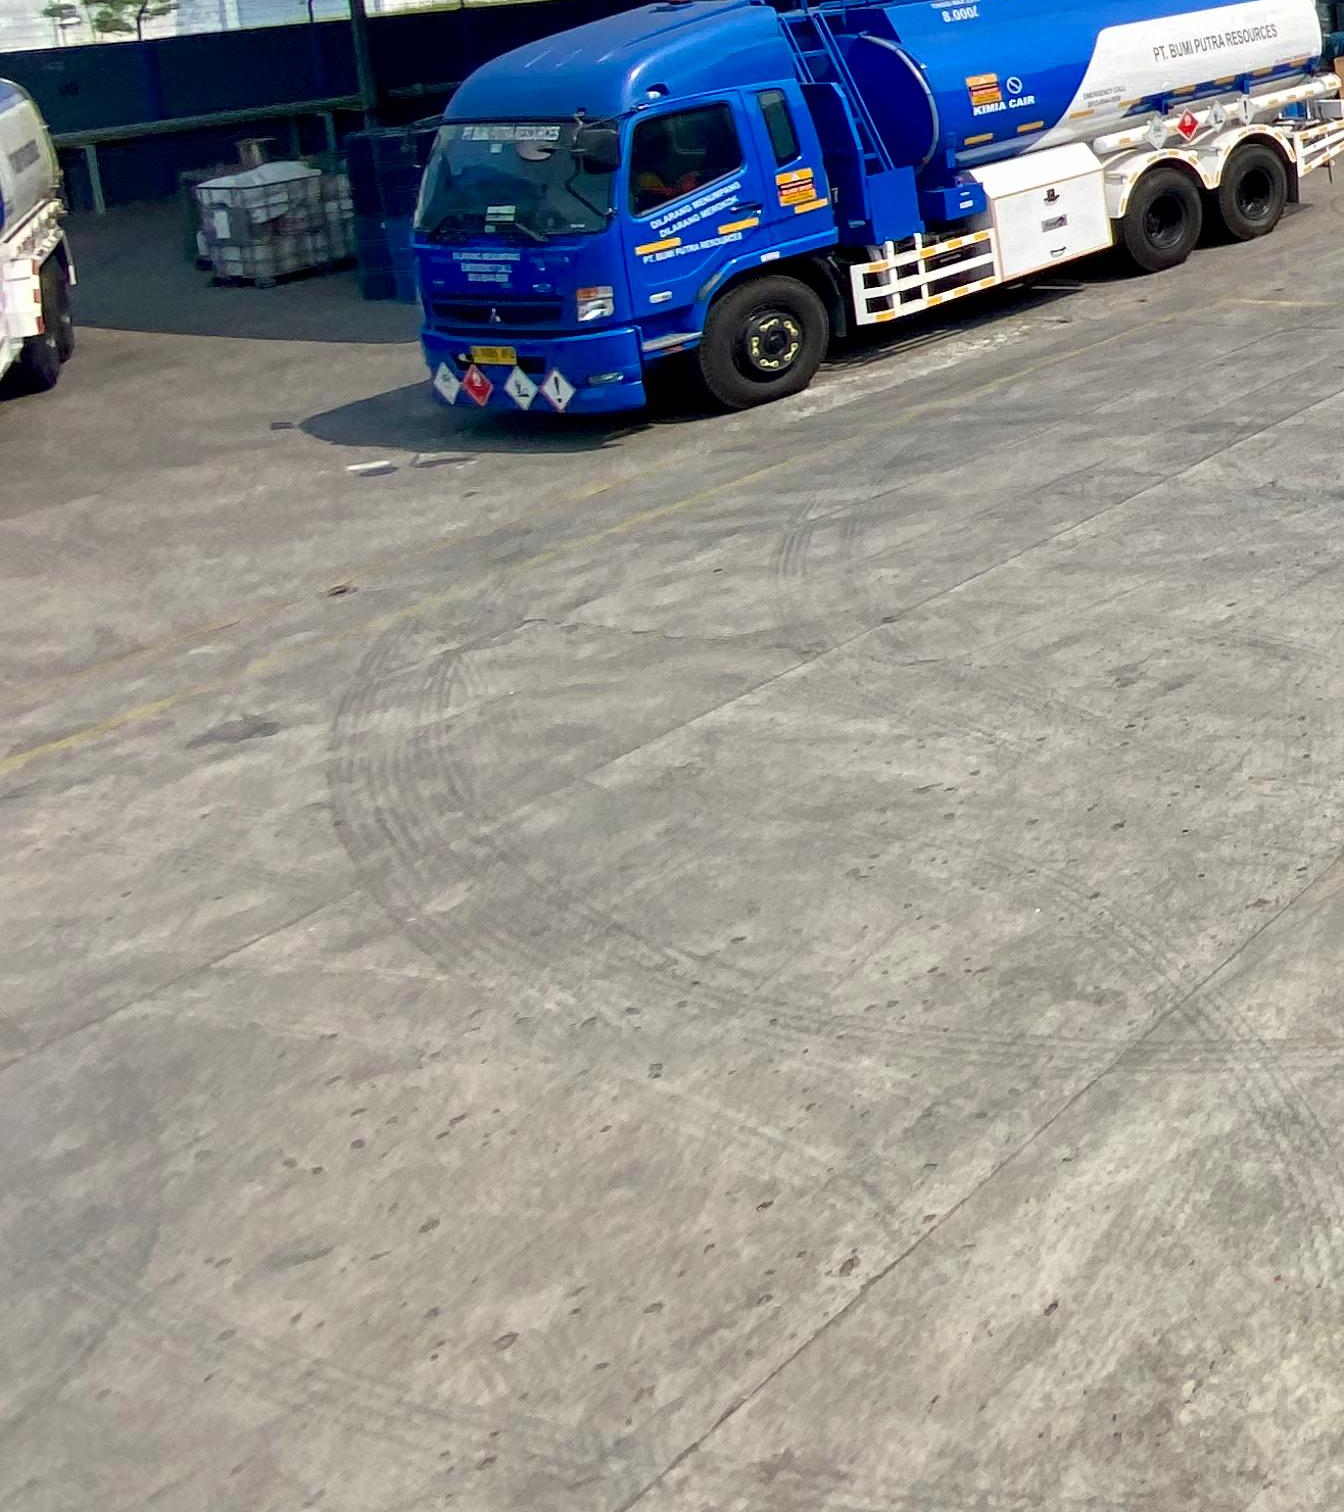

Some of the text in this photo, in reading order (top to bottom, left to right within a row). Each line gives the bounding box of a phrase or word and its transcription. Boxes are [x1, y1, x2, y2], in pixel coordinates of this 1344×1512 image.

[1153, 23, 1278, 62] PT. BUMI PUTRA RESOURCES
[973, 95, 1035, 117] KIMIA CAIR
[649, 205, 693, 230] DILARANG
[659, 213, 701, 238] DILARANG
